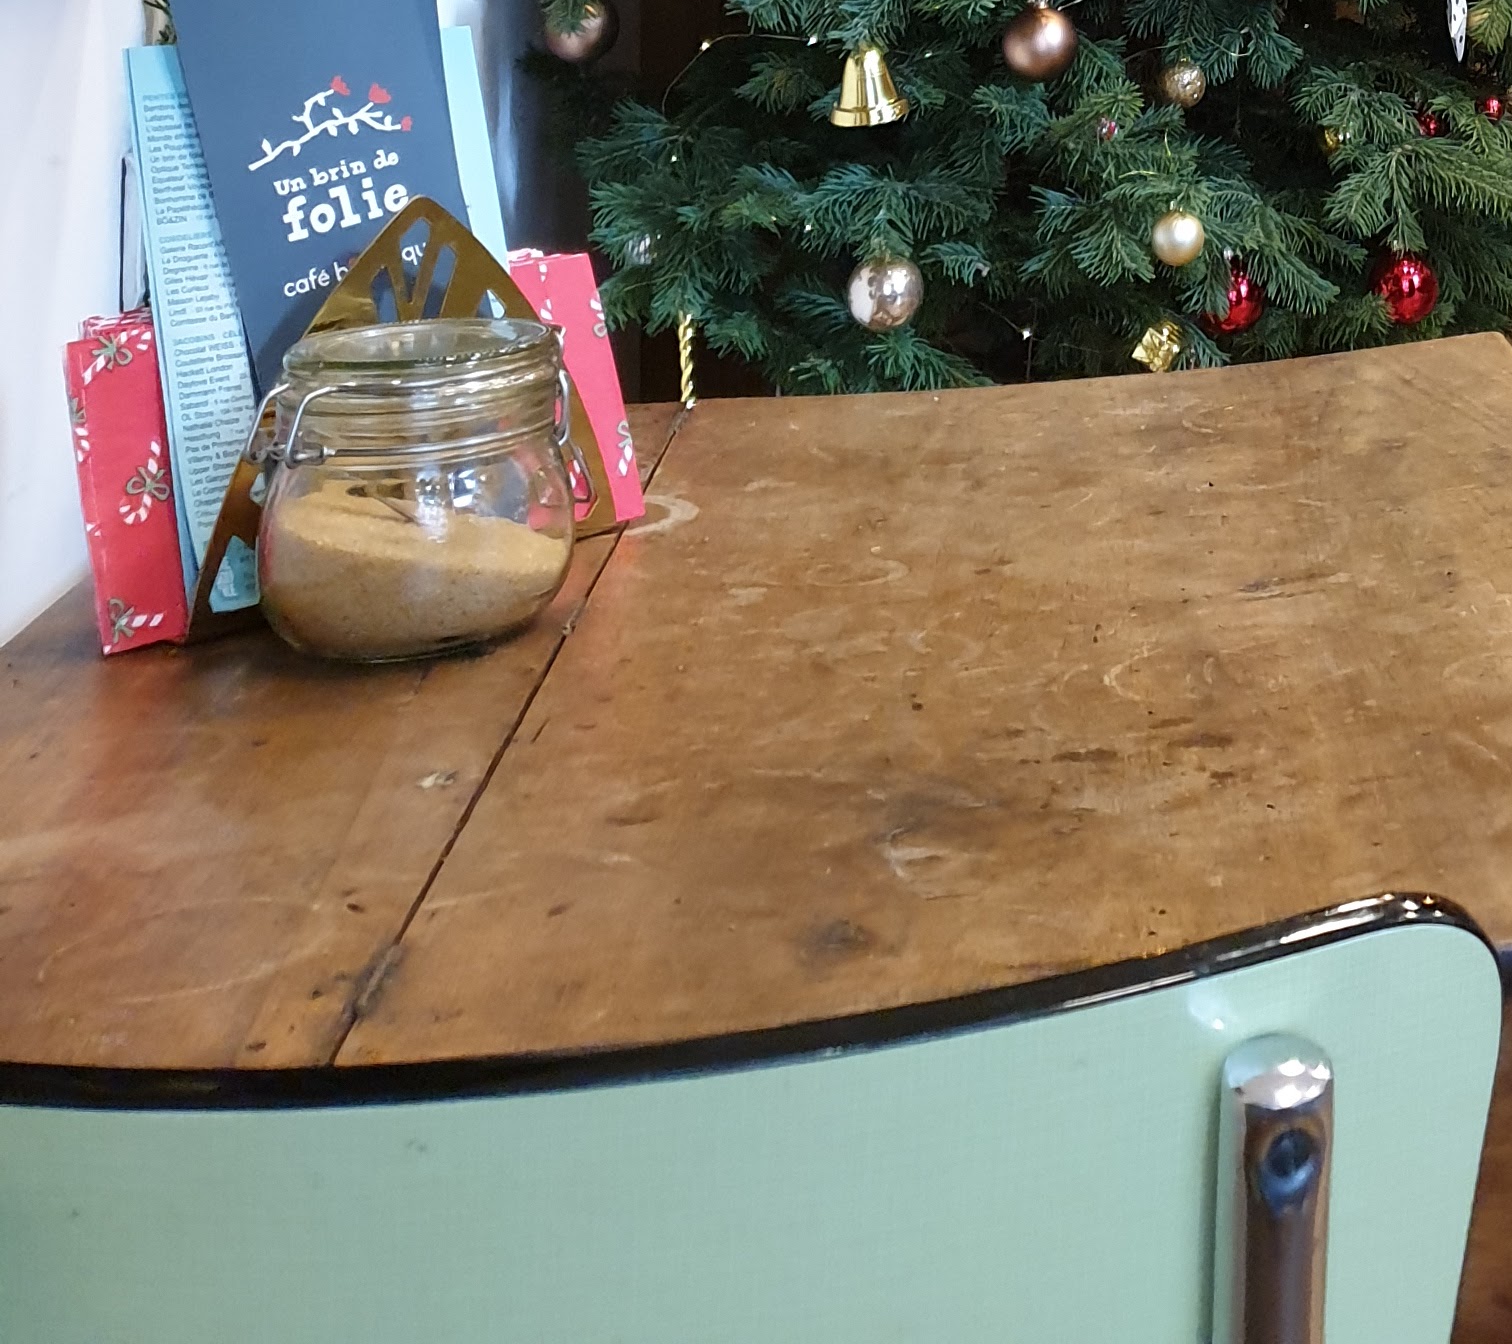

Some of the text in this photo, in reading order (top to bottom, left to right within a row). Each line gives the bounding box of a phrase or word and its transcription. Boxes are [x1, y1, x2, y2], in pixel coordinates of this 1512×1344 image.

[309, 159, 366, 187] brin
[373, 149, 399, 169] de
[283, 176, 409, 242] folie
[284, 268, 330, 297] café
